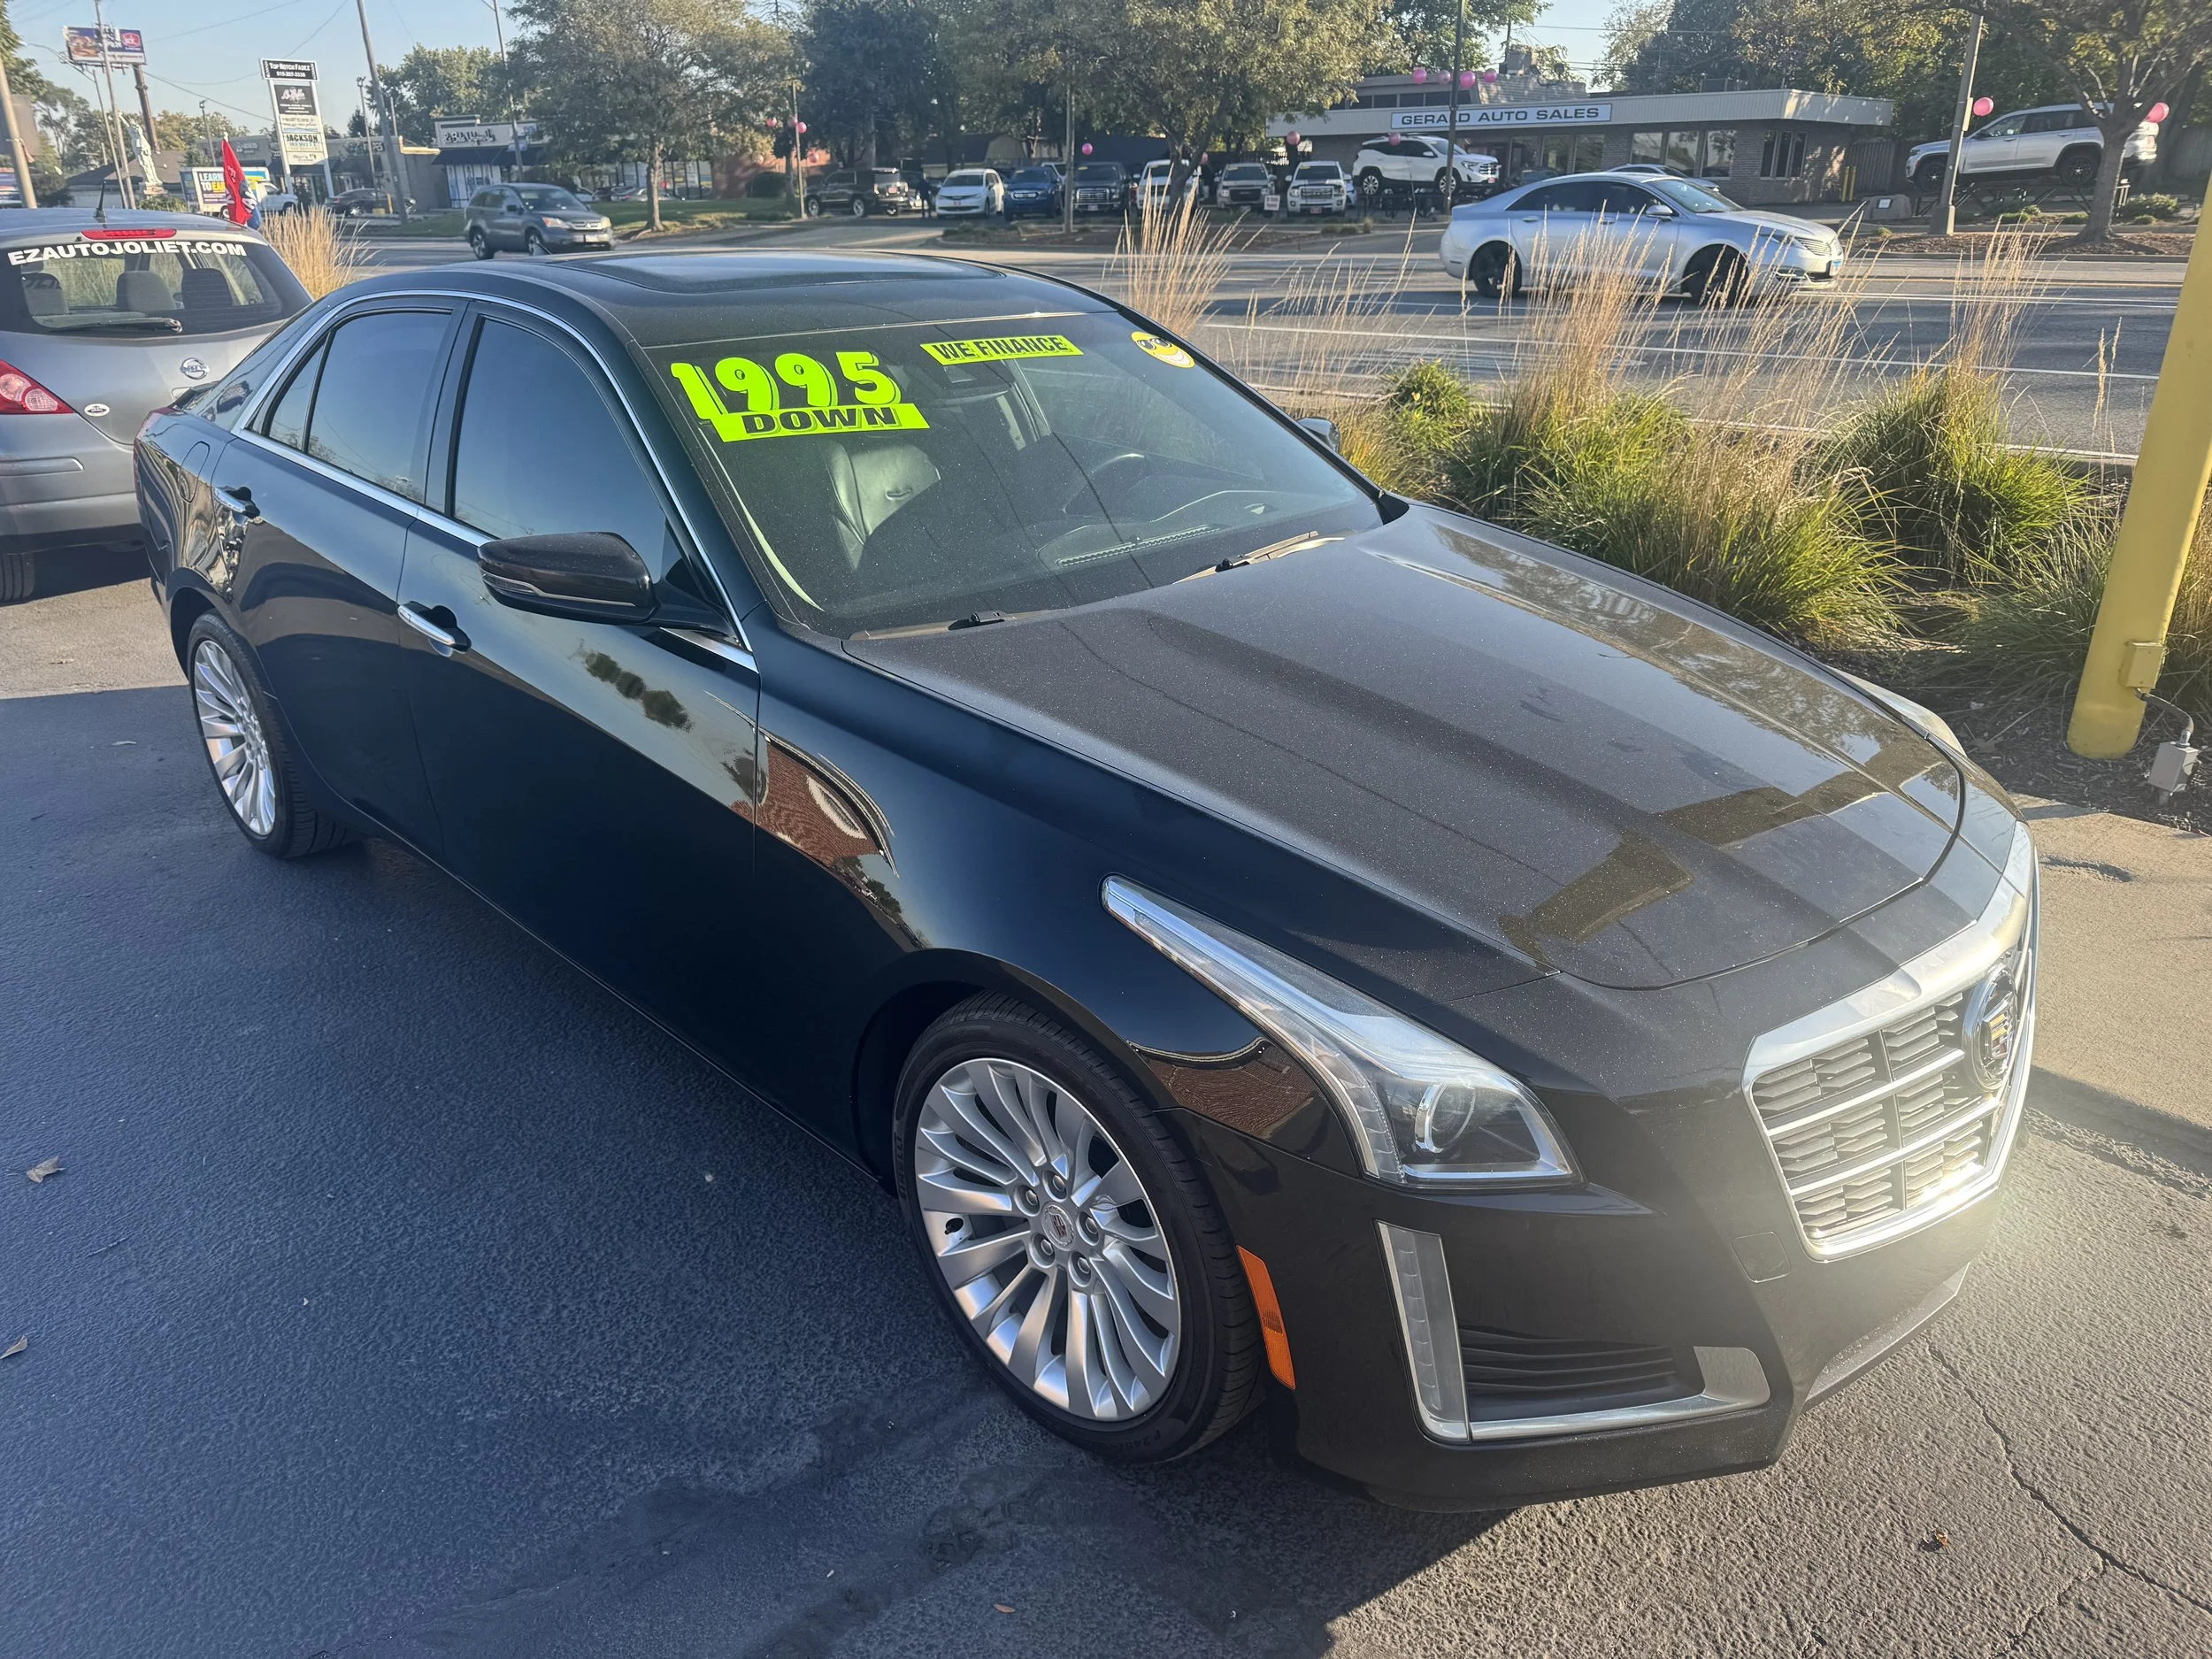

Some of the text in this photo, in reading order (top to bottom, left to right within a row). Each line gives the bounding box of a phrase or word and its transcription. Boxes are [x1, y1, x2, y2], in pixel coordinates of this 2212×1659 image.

[1402, 107, 1600, 125] GERAD AUTO SALES
[286, 134, 318, 142] JACKSON
[201, 182, 211, 191] TO
[8, 241, 247, 265] EZAUTOJOLIET.COM
[932, 336, 1071, 361] WE FINANCE
[671, 351, 901, 419] 1995
[741, 407, 900, 435] DOWN
